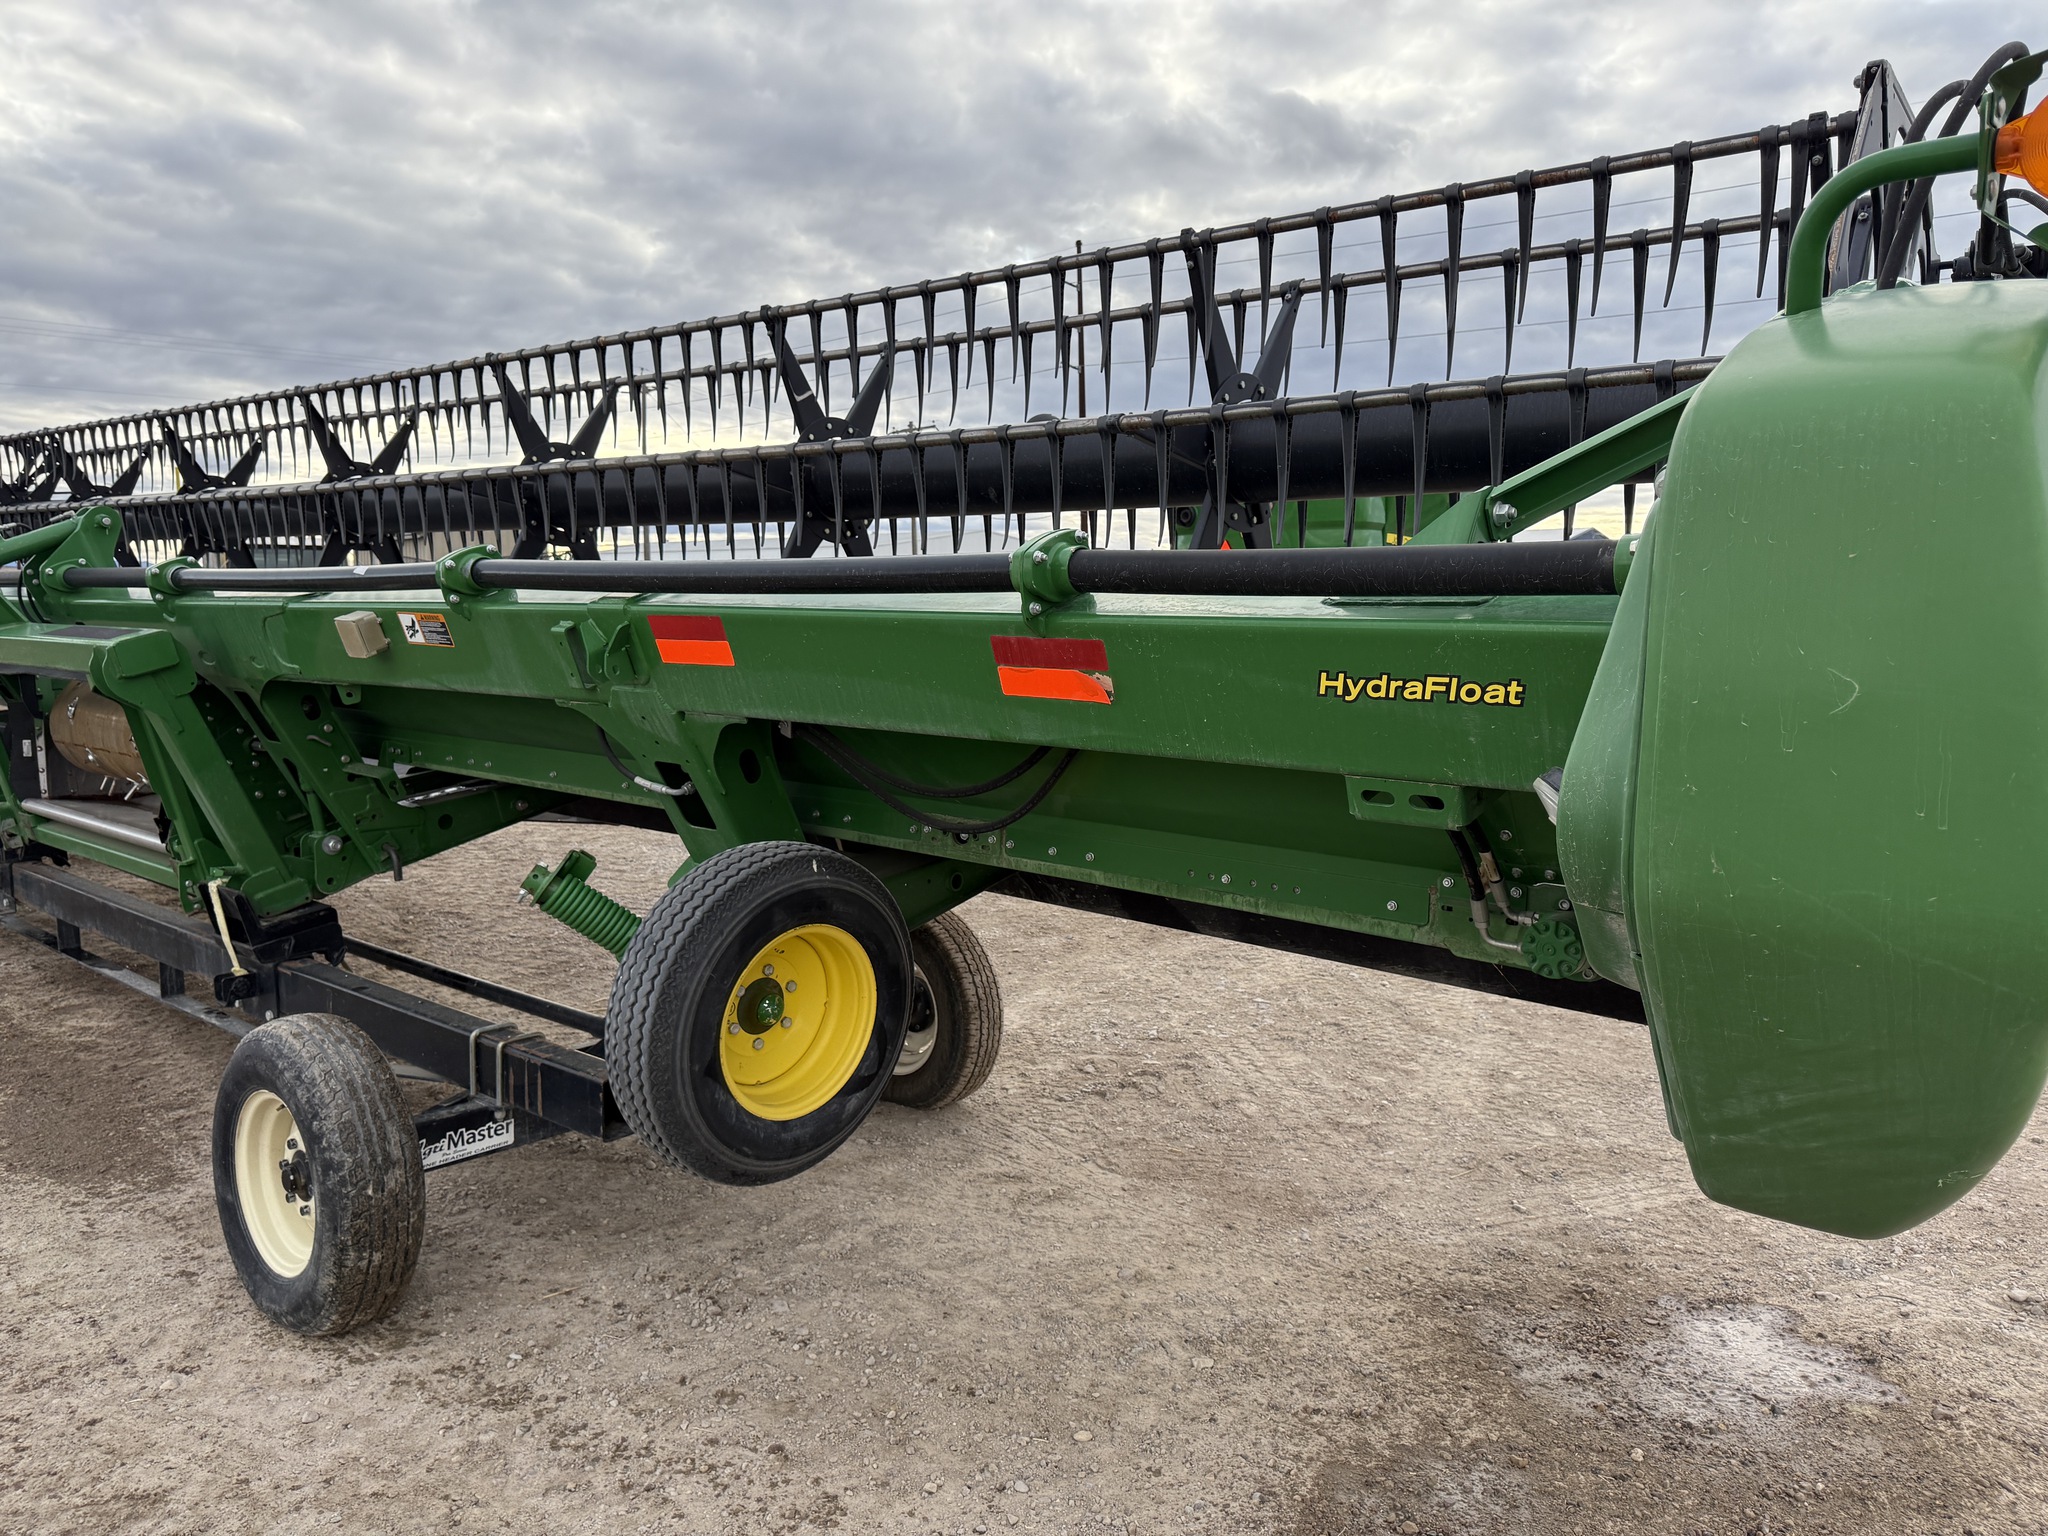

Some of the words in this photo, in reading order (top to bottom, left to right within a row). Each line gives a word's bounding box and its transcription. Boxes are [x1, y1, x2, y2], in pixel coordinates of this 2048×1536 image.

[1318, 671, 1525, 706] HydraFloat
[438, 1150, 473, 1164] HEADER
[474, 1140, 509, 1154] CARRIER
